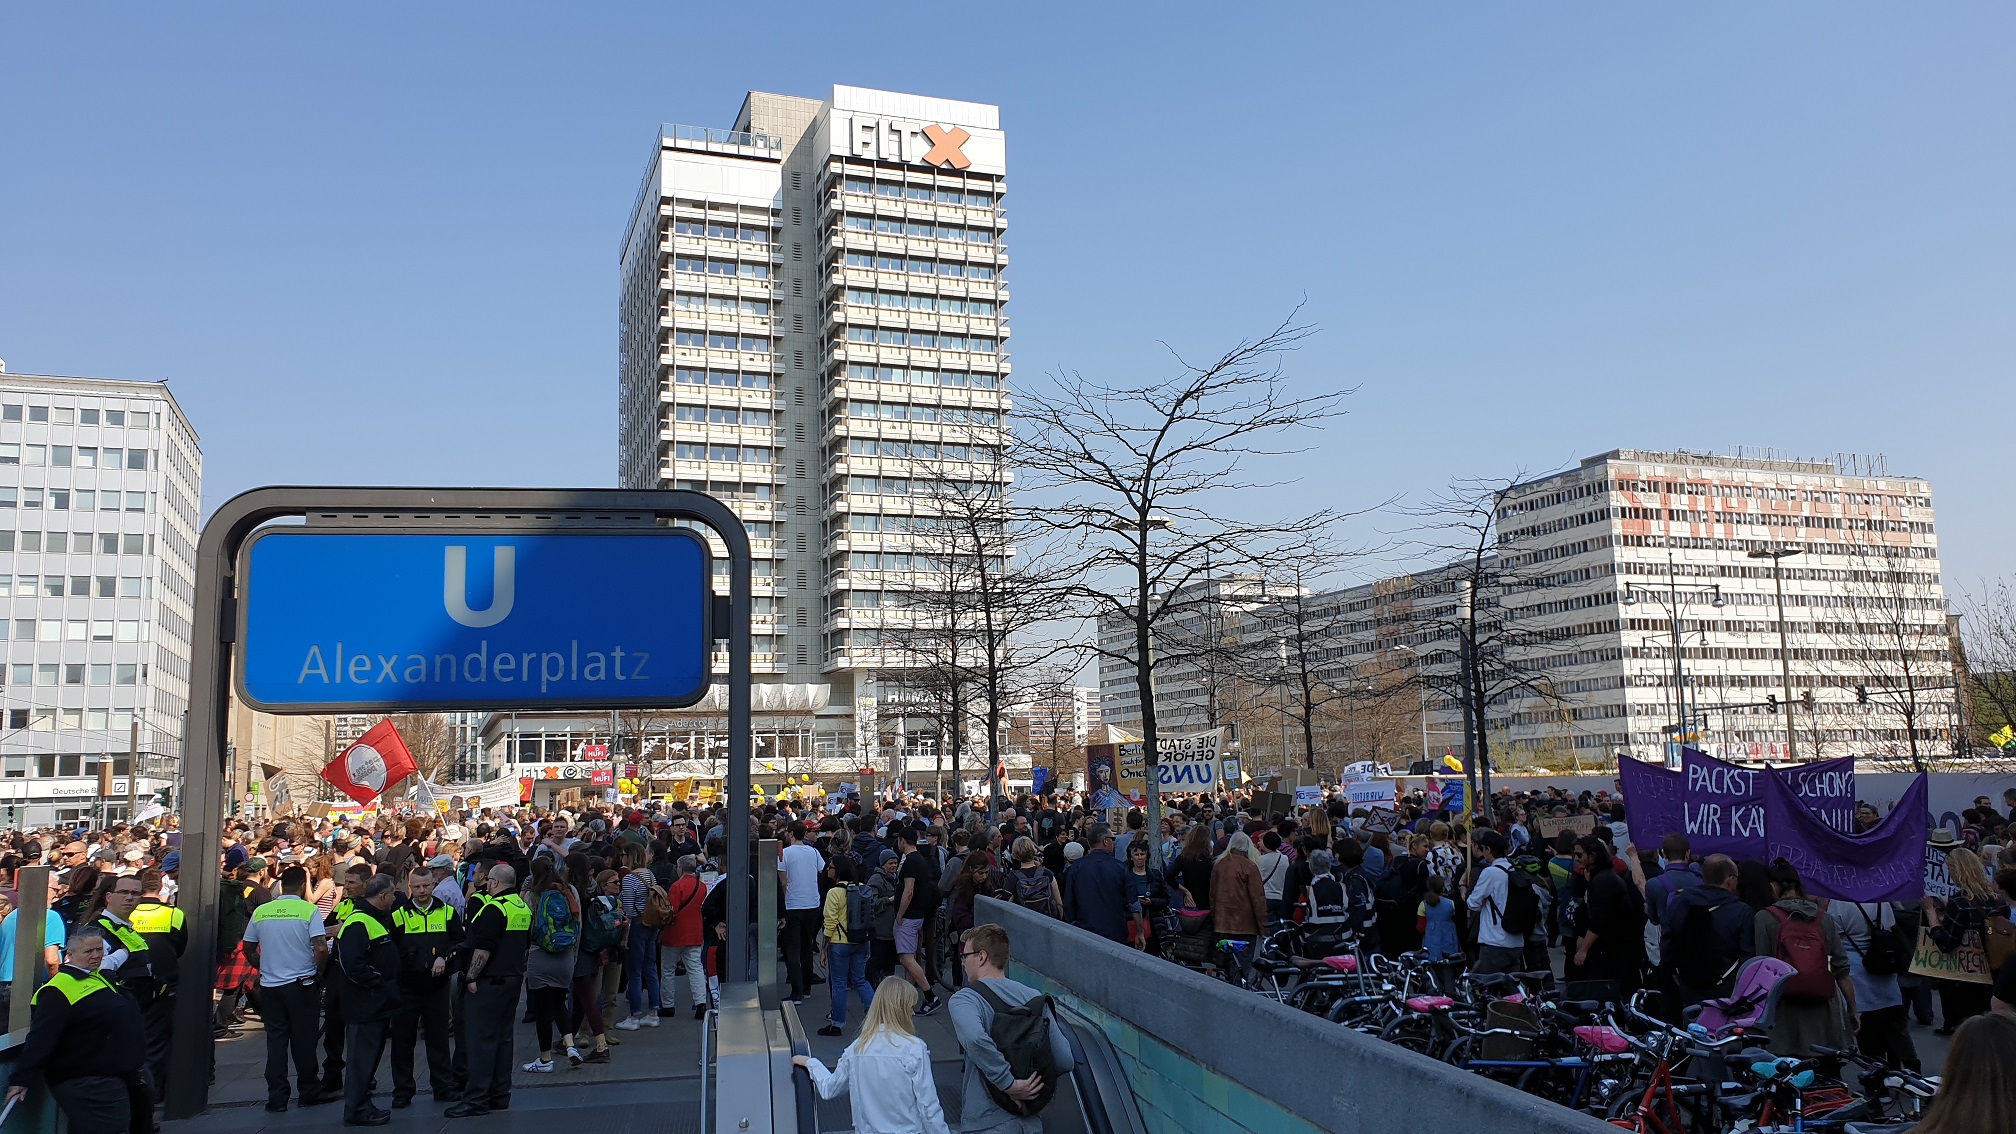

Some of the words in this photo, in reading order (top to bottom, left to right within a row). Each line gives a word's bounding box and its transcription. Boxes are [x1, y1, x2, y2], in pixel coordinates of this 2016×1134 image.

[851, 114, 972, 170] FITX
[443, 545, 516, 628] U
[297, 639, 650, 693] Alexanderplatz
[671, 719, 705, 728] Adecco
[522, 766, 560, 779] FITX
[1688, 763, 1759, 796] PACKST
[1798, 770, 1854, 798] SCHON?
[1683, 801, 1721, 837] WIR
